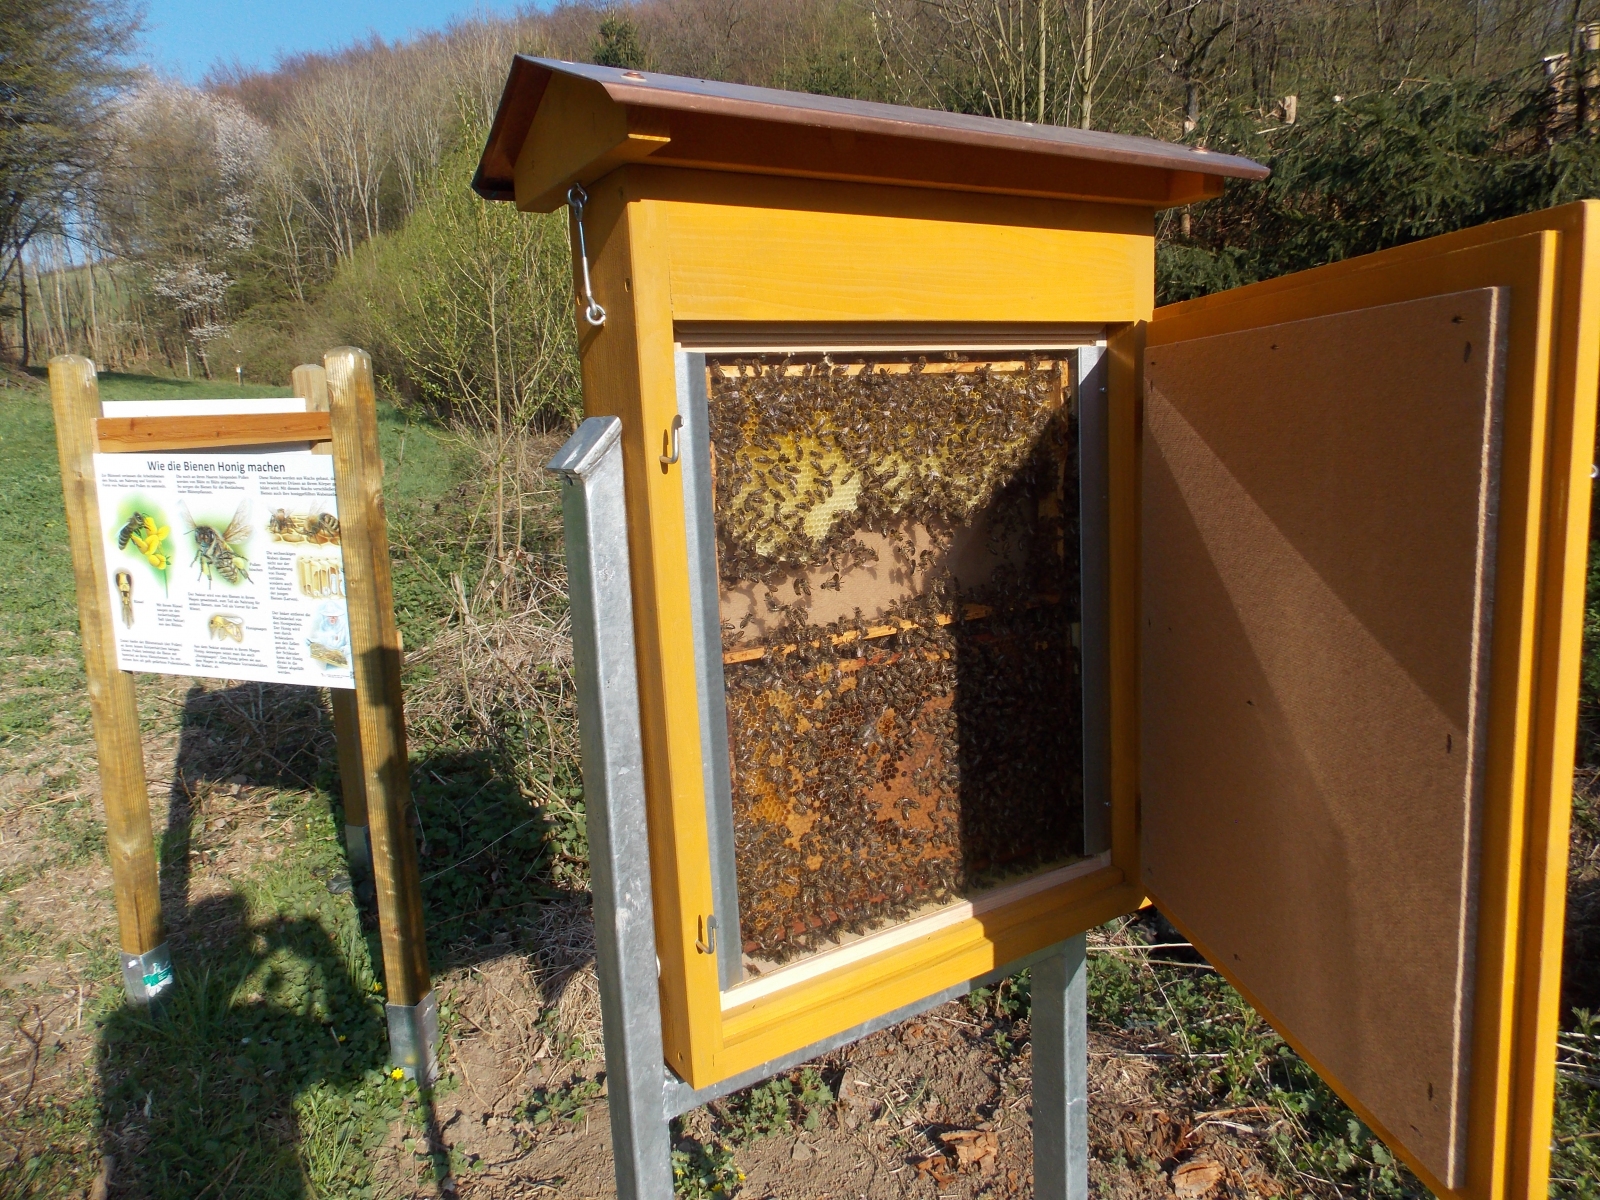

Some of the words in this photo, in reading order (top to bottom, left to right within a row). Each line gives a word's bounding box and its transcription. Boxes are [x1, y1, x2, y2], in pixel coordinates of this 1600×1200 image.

[147, 461, 165, 471] Wie
[167, 461, 181, 471] die
[183, 461, 215, 472] Bienen
[217, 461, 245, 474] Honig
[247, 461, 285, 472] machen
